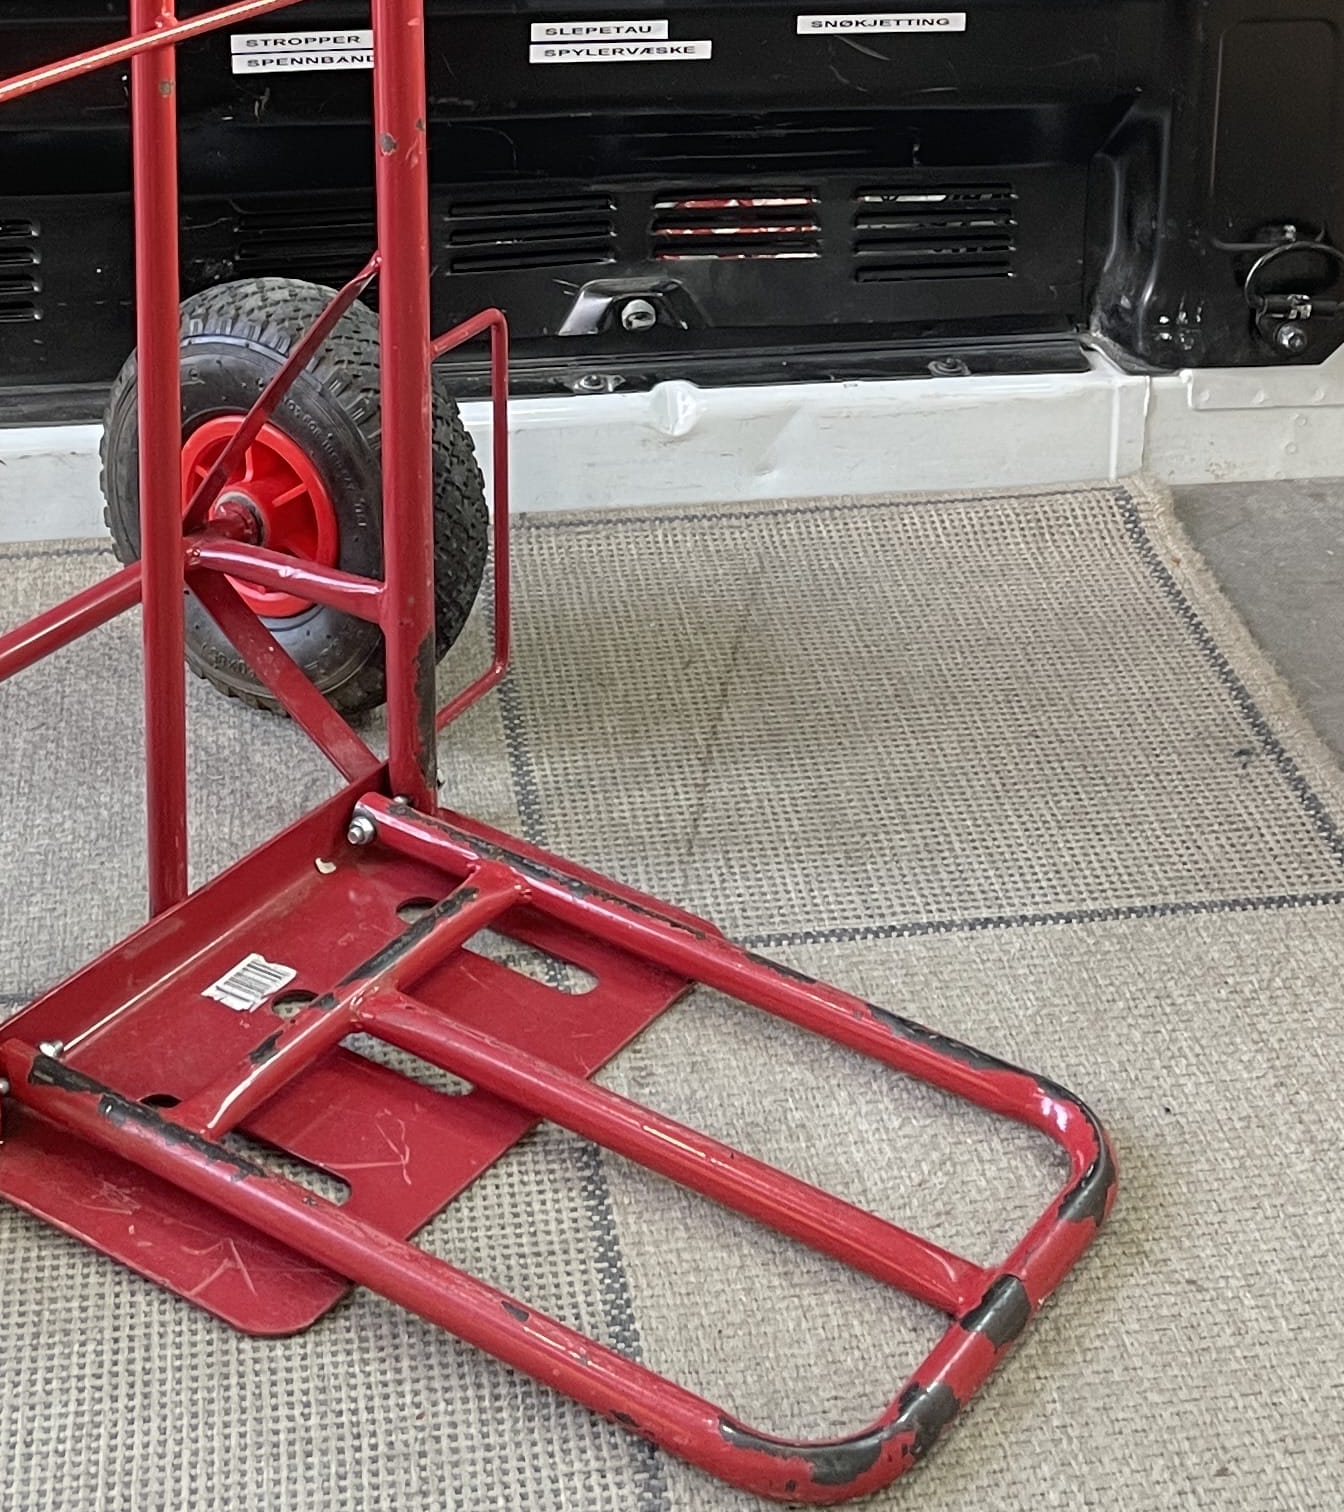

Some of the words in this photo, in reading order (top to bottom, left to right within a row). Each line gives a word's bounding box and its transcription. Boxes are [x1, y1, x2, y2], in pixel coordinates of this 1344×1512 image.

[810, 17, 951, 29] SNØKJETTING
[544, 24, 653, 37] SLEPETAU
[245, 35, 361, 48] STROPPER
[543, 45, 697, 58] SPYLERVÆSKE
